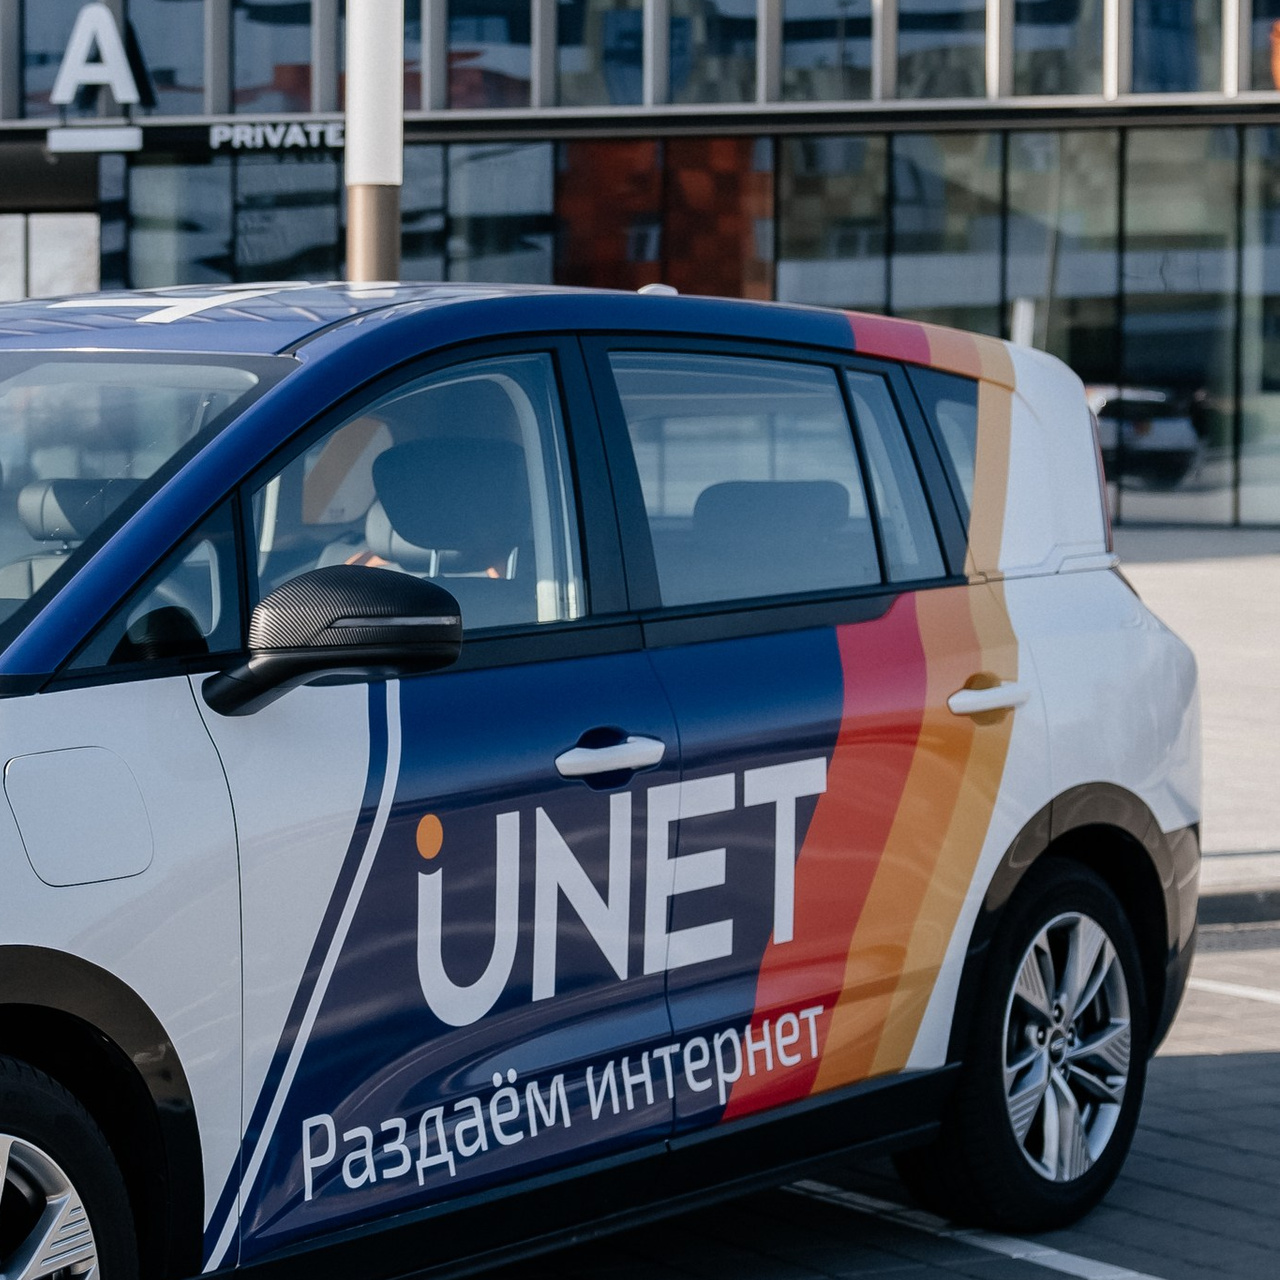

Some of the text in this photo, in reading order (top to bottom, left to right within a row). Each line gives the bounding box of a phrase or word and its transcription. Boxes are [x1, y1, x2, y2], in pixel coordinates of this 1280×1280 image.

[49, 2, 140, 105] A
[209, 123, 345, 149] PRIVATE
[301, 1006, 824, 1201] Раздаём интернет
